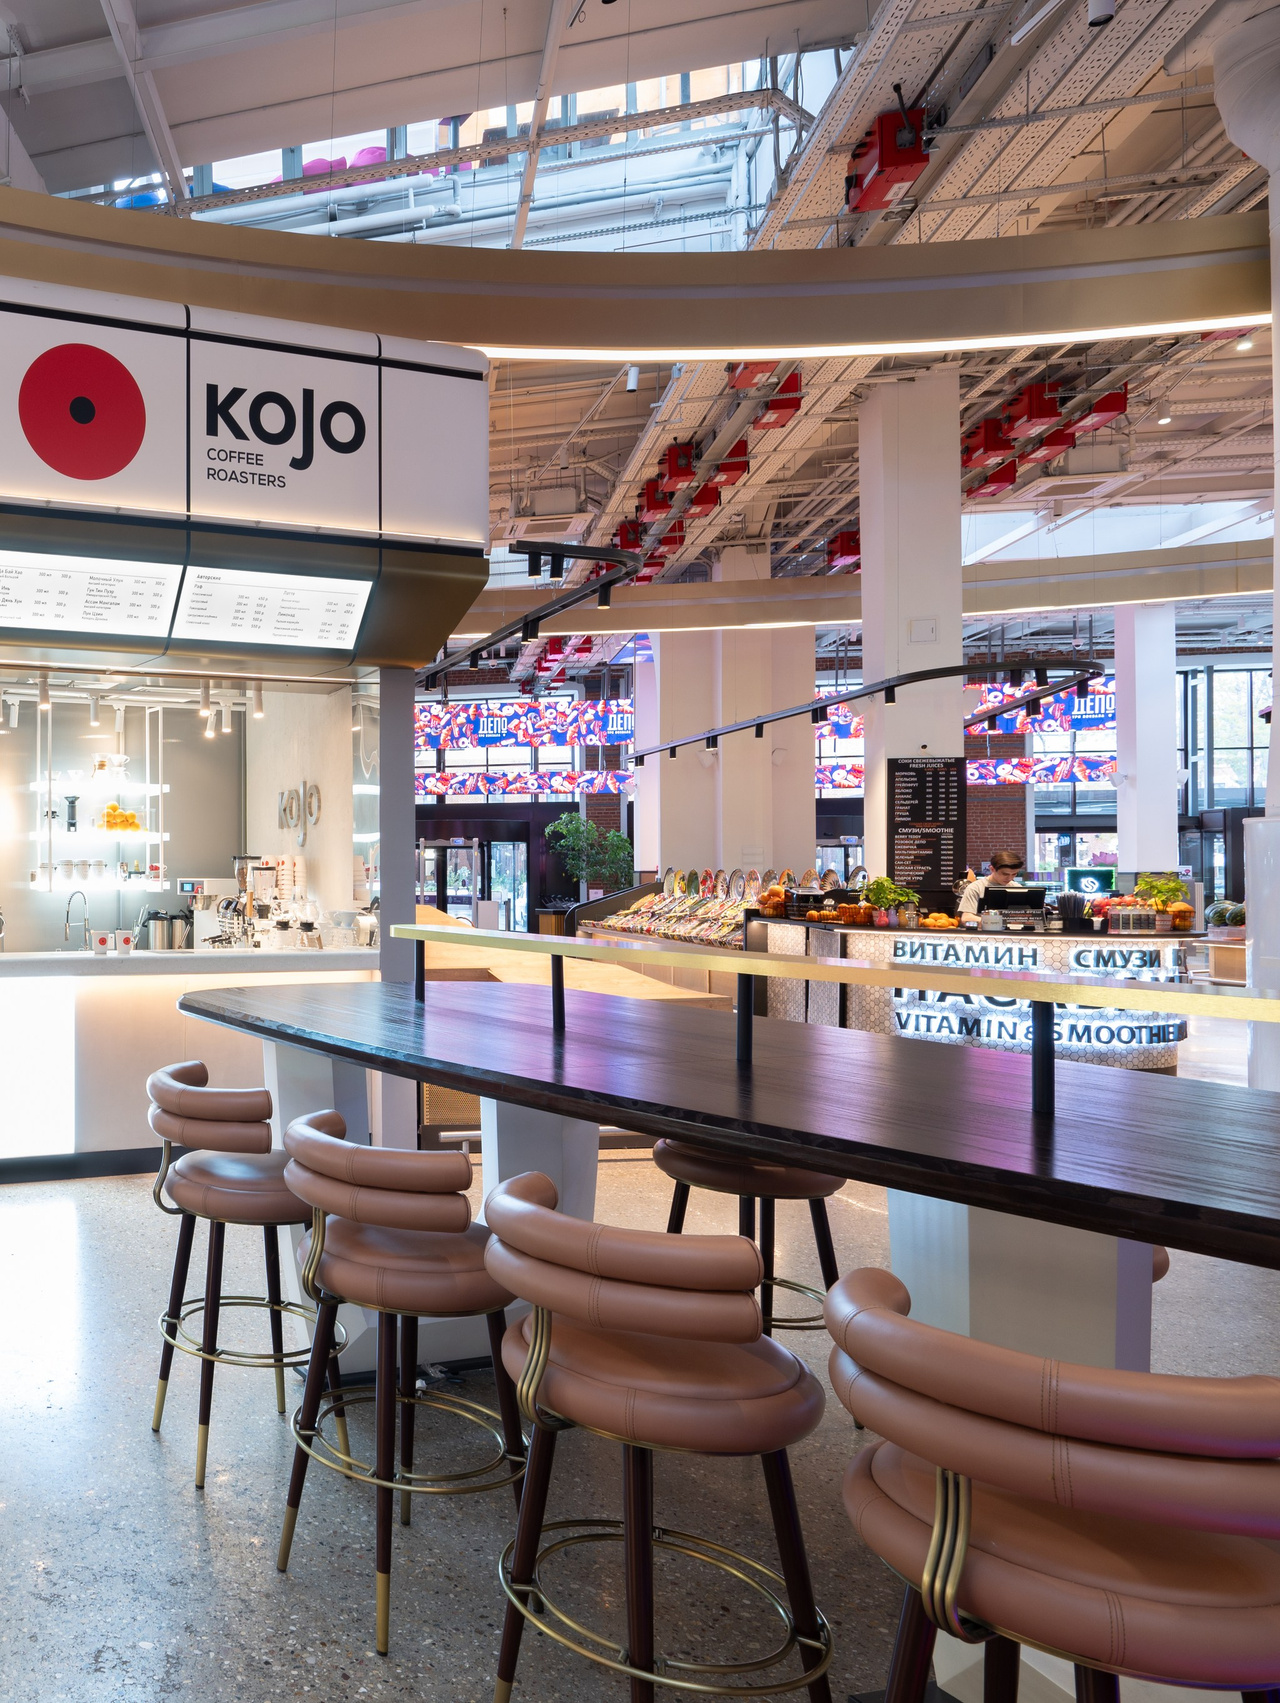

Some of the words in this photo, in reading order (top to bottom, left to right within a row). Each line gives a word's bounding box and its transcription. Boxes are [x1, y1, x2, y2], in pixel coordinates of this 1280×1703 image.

[206, 382, 366, 470] KOJO
[206, 448, 264, 466] COFFEE
[206, 468, 286, 488] ROASTERS
[1072, 694, 1115, 714] ДЕПО
[478, 718, 507, 734] ДЕПО
[893, 940, 1038, 966] ВИТАМИН
[1073, 949, 1161, 968] СМУЗИ
[896, 1012, 1018, 1041] VITAMIN
